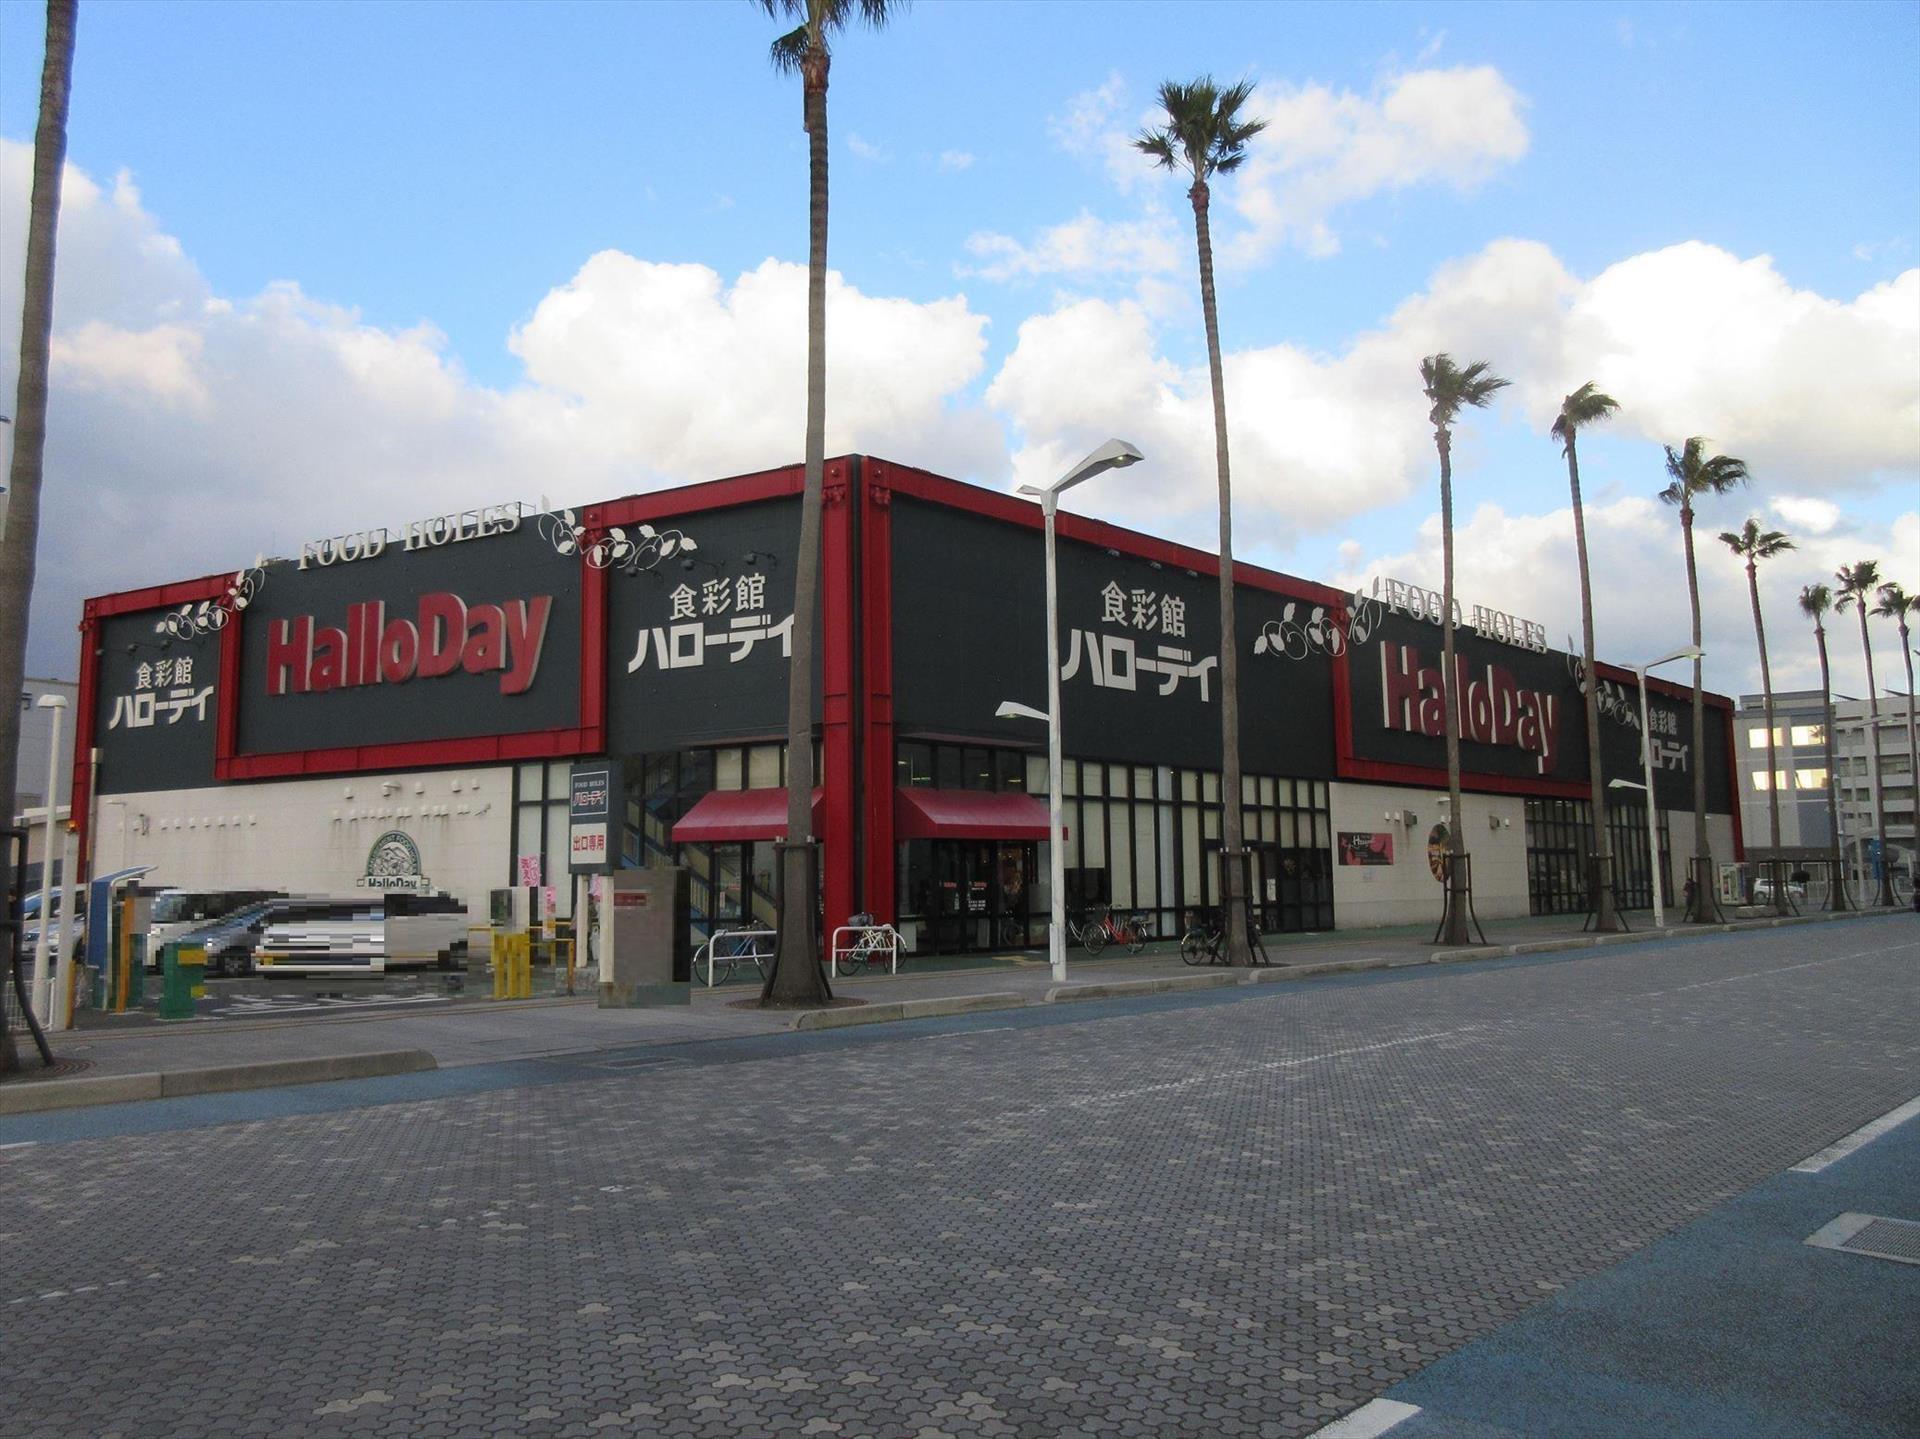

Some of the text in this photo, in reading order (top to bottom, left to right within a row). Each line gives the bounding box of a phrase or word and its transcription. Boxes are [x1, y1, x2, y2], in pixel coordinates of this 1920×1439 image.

[298, 502, 521, 570] FOOD HOLES
[669, 572, 766, 621] 食彩館
[1101, 580, 1186, 638] 食彩館
[266, 592, 552, 695] HalloDay
[628, 613, 795, 674] ハローディ
[1473, 604, 1548, 654] HOLES
[135, 656, 193, 690] 食彩館
[1060, 628, 1218, 703] ハローディ
[109, 685, 215, 730] ハローディ
[1380, 640, 1561, 774] HaloDay
[573, 835, 605, 852] 出口専用
